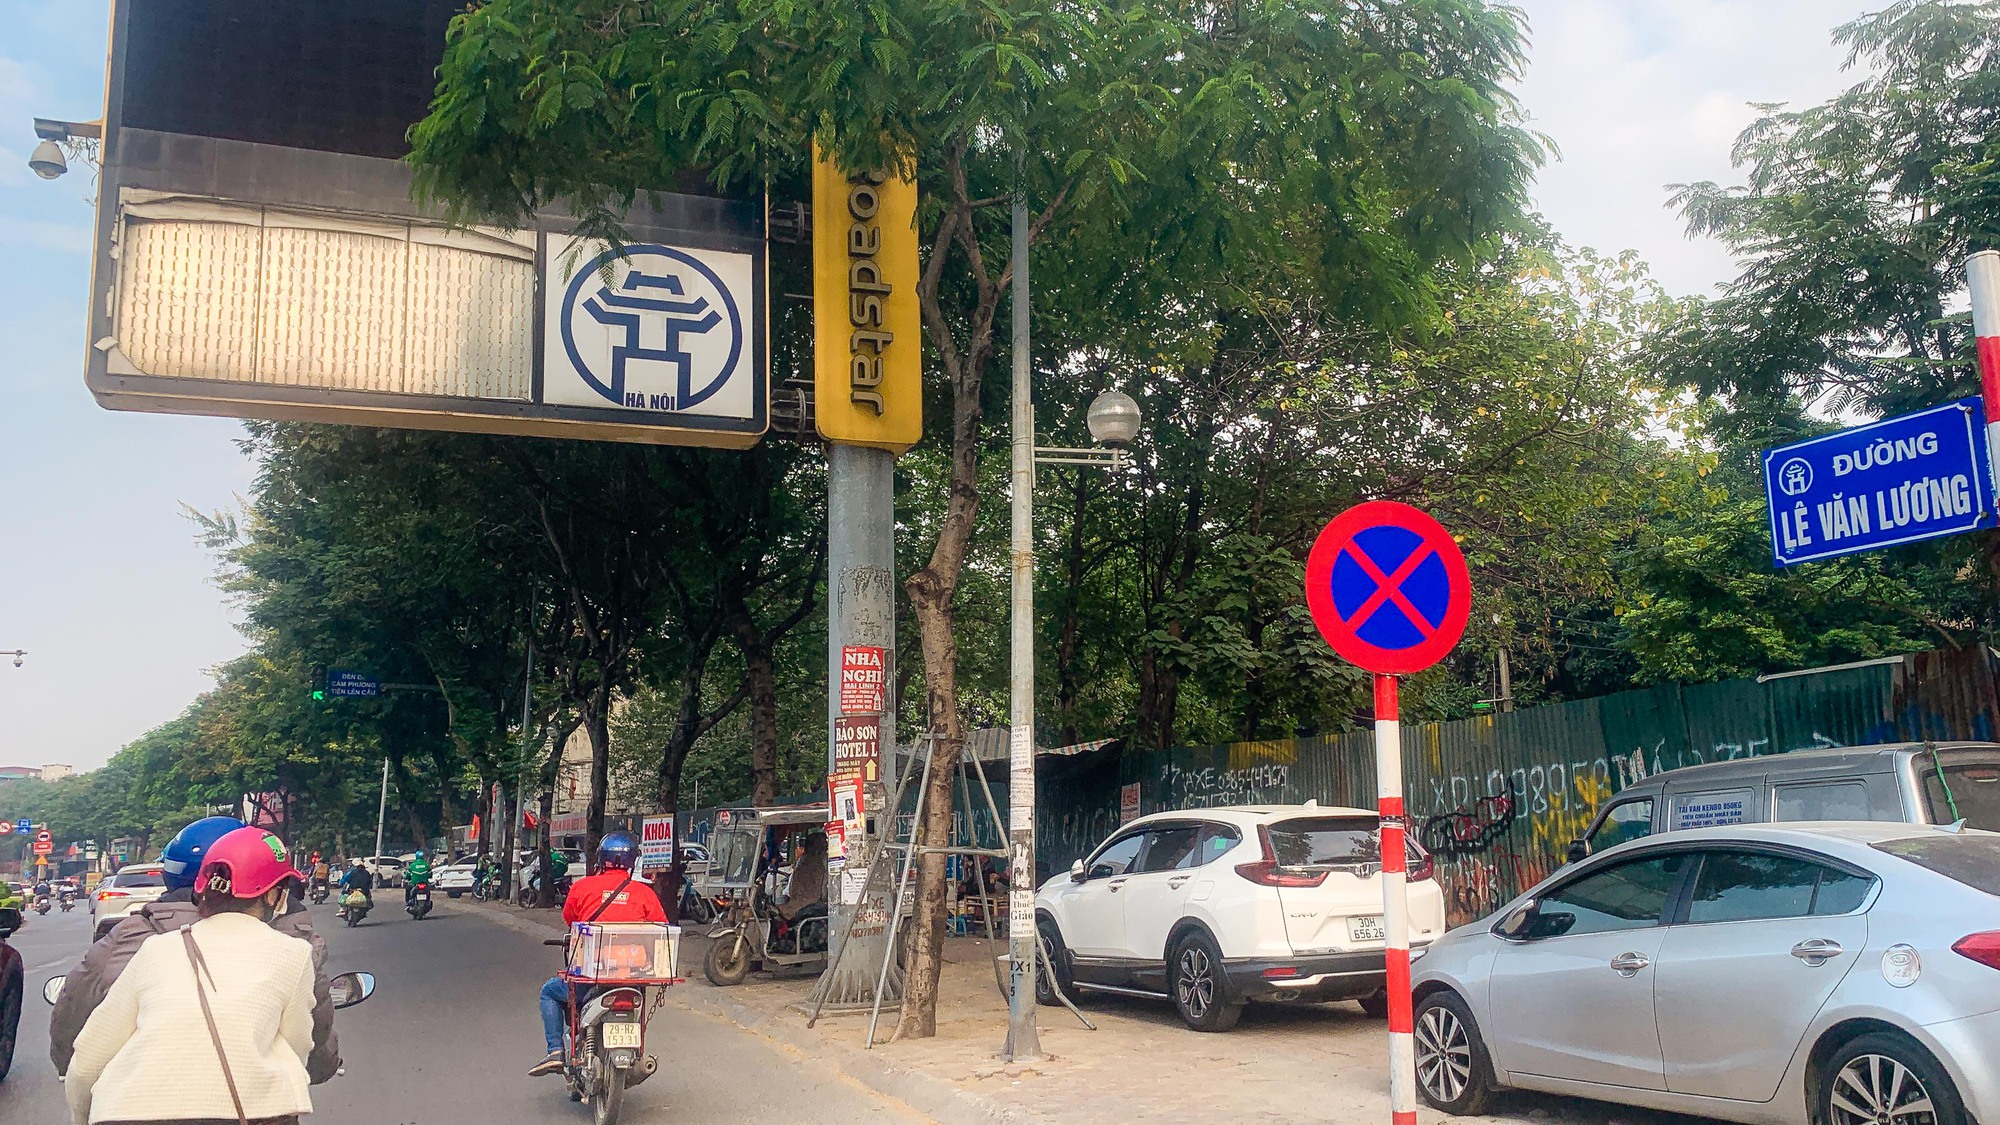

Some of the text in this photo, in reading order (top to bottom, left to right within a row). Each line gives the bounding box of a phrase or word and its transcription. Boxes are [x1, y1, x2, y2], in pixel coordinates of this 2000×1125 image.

[625, 390, 676, 413] HÀ NỘI
[1832, 431, 1939, 477] ĐƯỜNG
[1780, 473, 1972, 549] LÊ VĂN LƯƠNG
[844, 650, 881, 666] NHÀ
[843, 666, 882, 683] NGHỈ
[836, 722, 877, 741] BẢO SƠN
[836, 741, 878, 759] HOTEL L
[644, 819, 671, 841] KHÓA
[1010, 909, 1033, 920] Giáo
[1358, 917, 1376, 928] 30H
[1353, 928, 1385, 940] 656.26
[609, 1024, 635, 1035] 29-H2
[607, 1035, 638, 1046] 153.31
